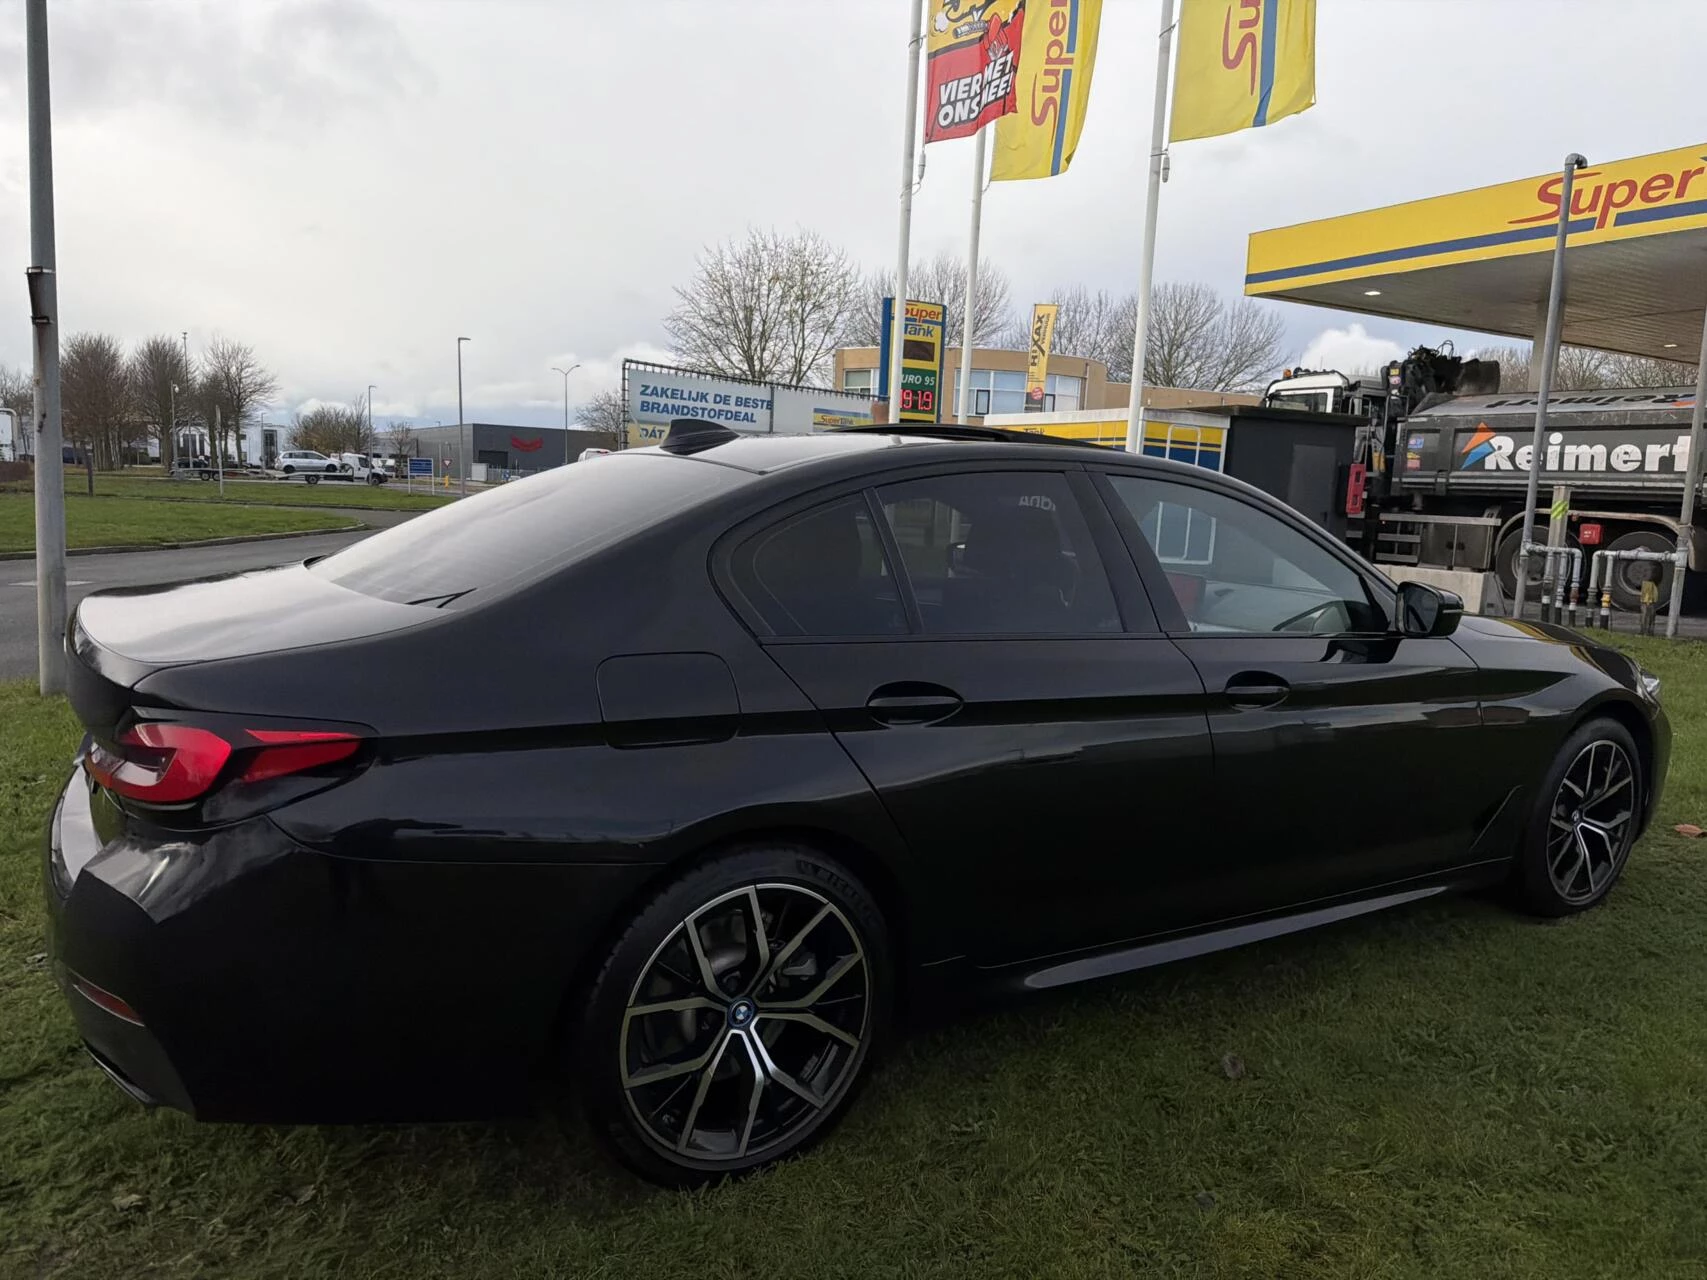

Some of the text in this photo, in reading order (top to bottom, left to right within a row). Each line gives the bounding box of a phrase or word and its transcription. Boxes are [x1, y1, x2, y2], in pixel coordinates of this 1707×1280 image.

[939, 72, 982, 104] VIER
[939, 94, 979, 127] ONS
[1507, 167, 1706, 230] Super
[901, 374, 936, 386] URO 95
[640, 384, 774, 411] ZAKELIJK DE BESTE
[640, 400, 757, 423] BRANDSTOFDEAL
[1484, 431, 1692, 472] Reimert
